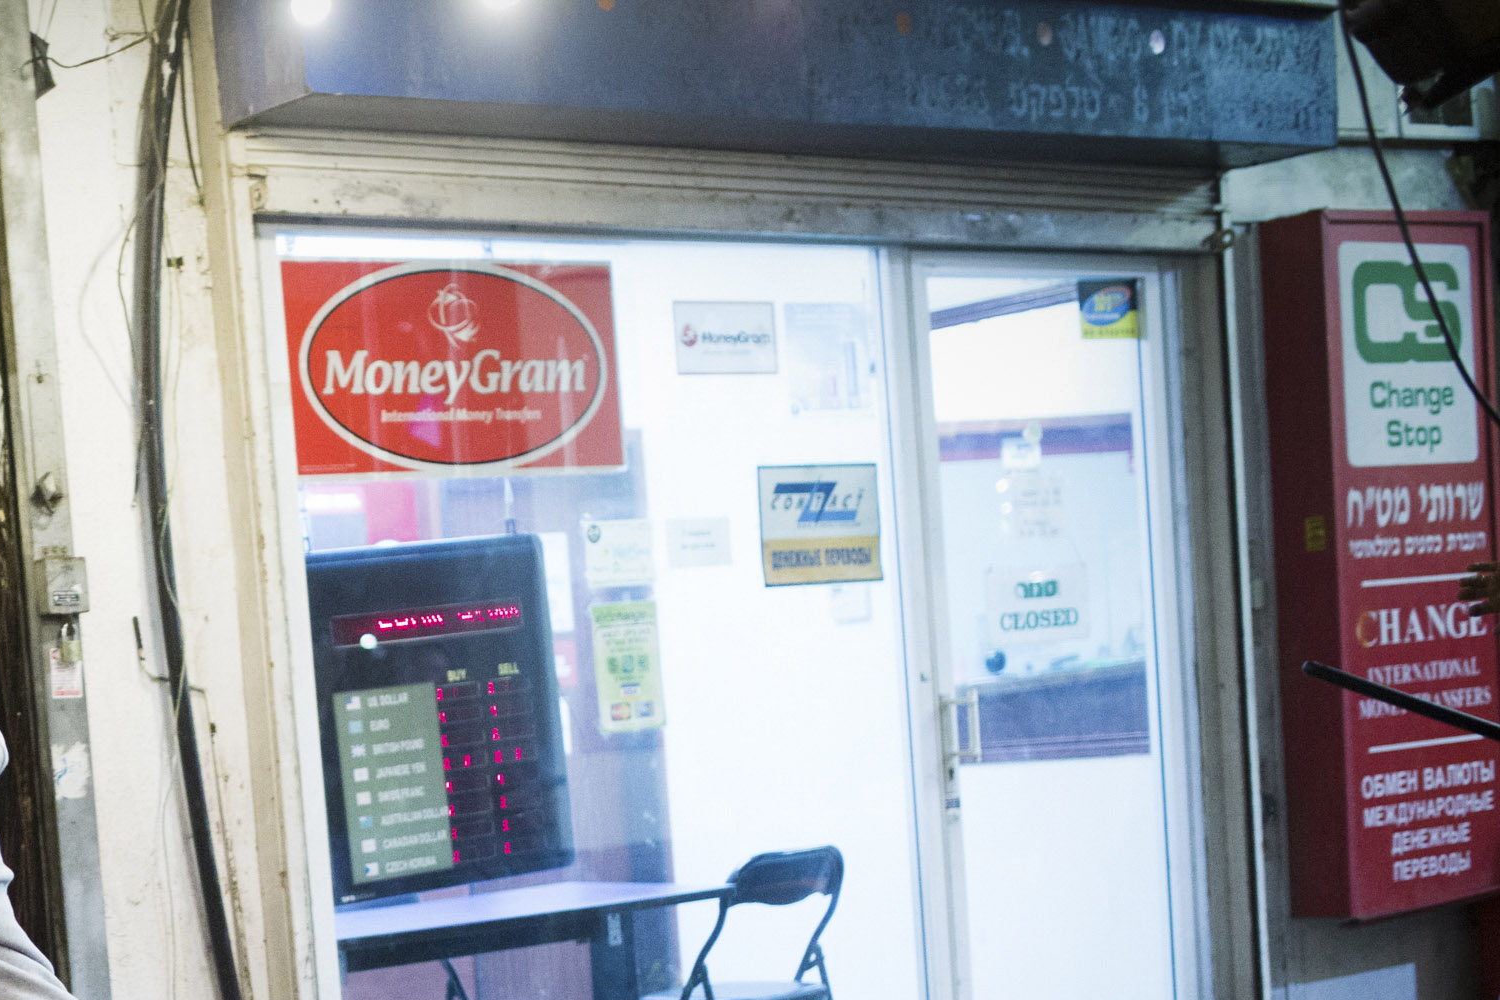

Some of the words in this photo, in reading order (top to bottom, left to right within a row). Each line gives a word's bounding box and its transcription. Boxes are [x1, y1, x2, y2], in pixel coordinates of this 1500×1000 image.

[322, 349, 587, 405] MoneyGram
[1369, 381, 1455, 415] Change
[1386, 420, 1442, 452] Stop
[1417, 482, 1484, 523] שרותי
[1000, 607, 1079, 630] CLOSED
[1356, 601, 1488, 648] CHANGE
[1367, 656, 1481, 685] INTERNATIONAL
[1358, 694, 1408, 719] MONE
[1361, 769, 1418, 799] ОБМЕН
[1423, 759, 1495, 791] ВАЛЮТЫ
[1391, 821, 1471, 857] ДЕНЕЖНЫЕ
[1393, 849, 1471, 882] ПЕРЕВОДЫ
